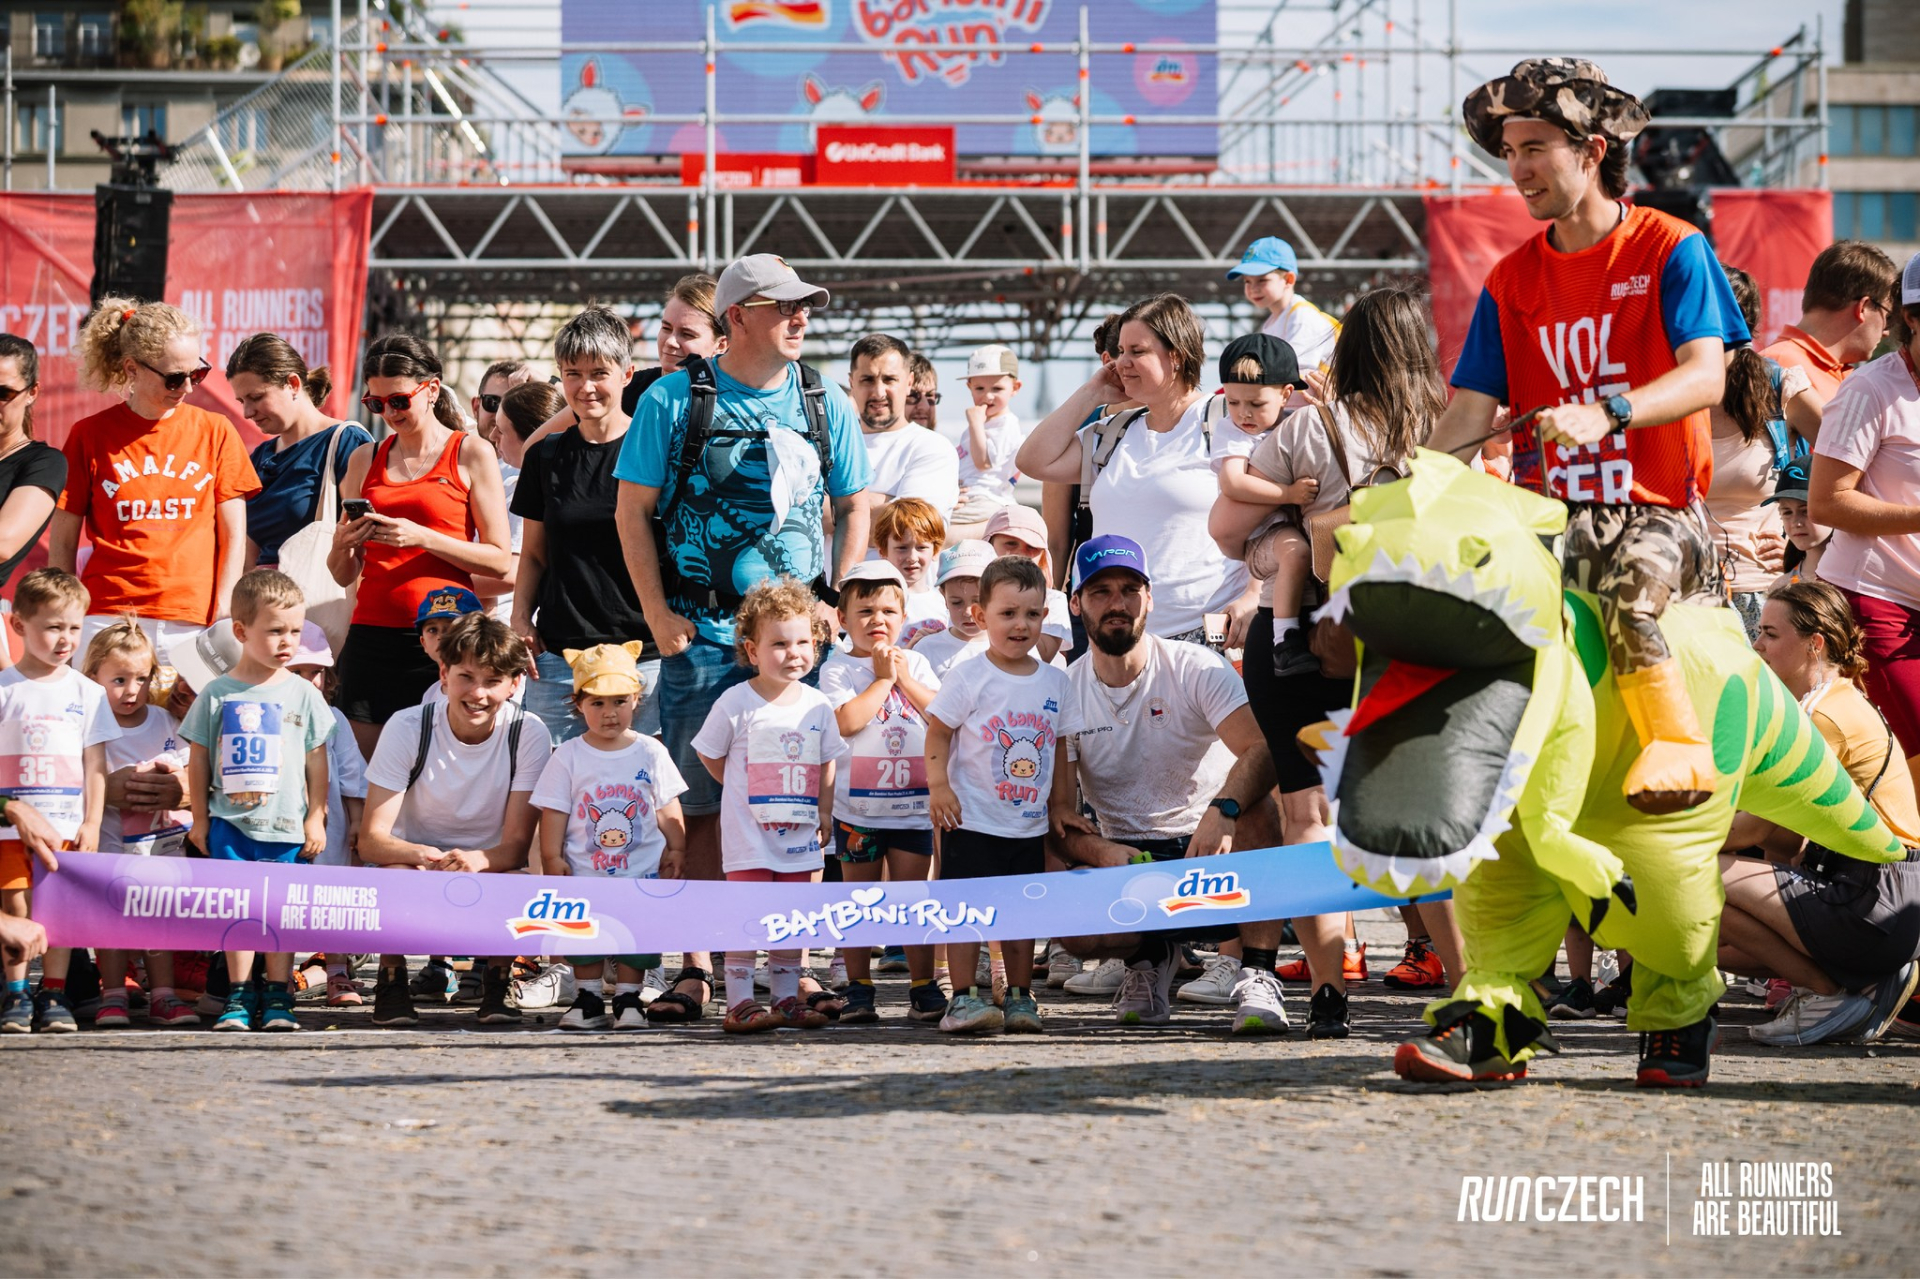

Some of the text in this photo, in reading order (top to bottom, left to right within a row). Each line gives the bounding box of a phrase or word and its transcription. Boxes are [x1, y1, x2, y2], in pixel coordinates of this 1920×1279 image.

[908, 142, 945, 162] Bank
[222, 288, 325, 331] RUNNERS
[1538, 313, 1627, 389] VOL
[101, 454, 214, 499] AMALFI
[116, 497, 197, 522] COAST
[1085, 548, 1138, 563] VAPOR
[231, 736, 266, 765] 39
[19, 756, 56, 786] 35
[778, 765, 807, 795] 16
[877, 759, 911, 788] 26
[998, 781, 1038, 804] Run
[592, 850, 629, 871] Run
[286, 883, 378, 908] ALL RUNNERS
[1178, 871, 1234, 897] dm
[123, 885, 250, 919] RUNCZECH
[528, 893, 585, 920] dm
[910, 899, 996, 933] RUN
[280, 905, 382, 931] ARE BEAUTIFUL
